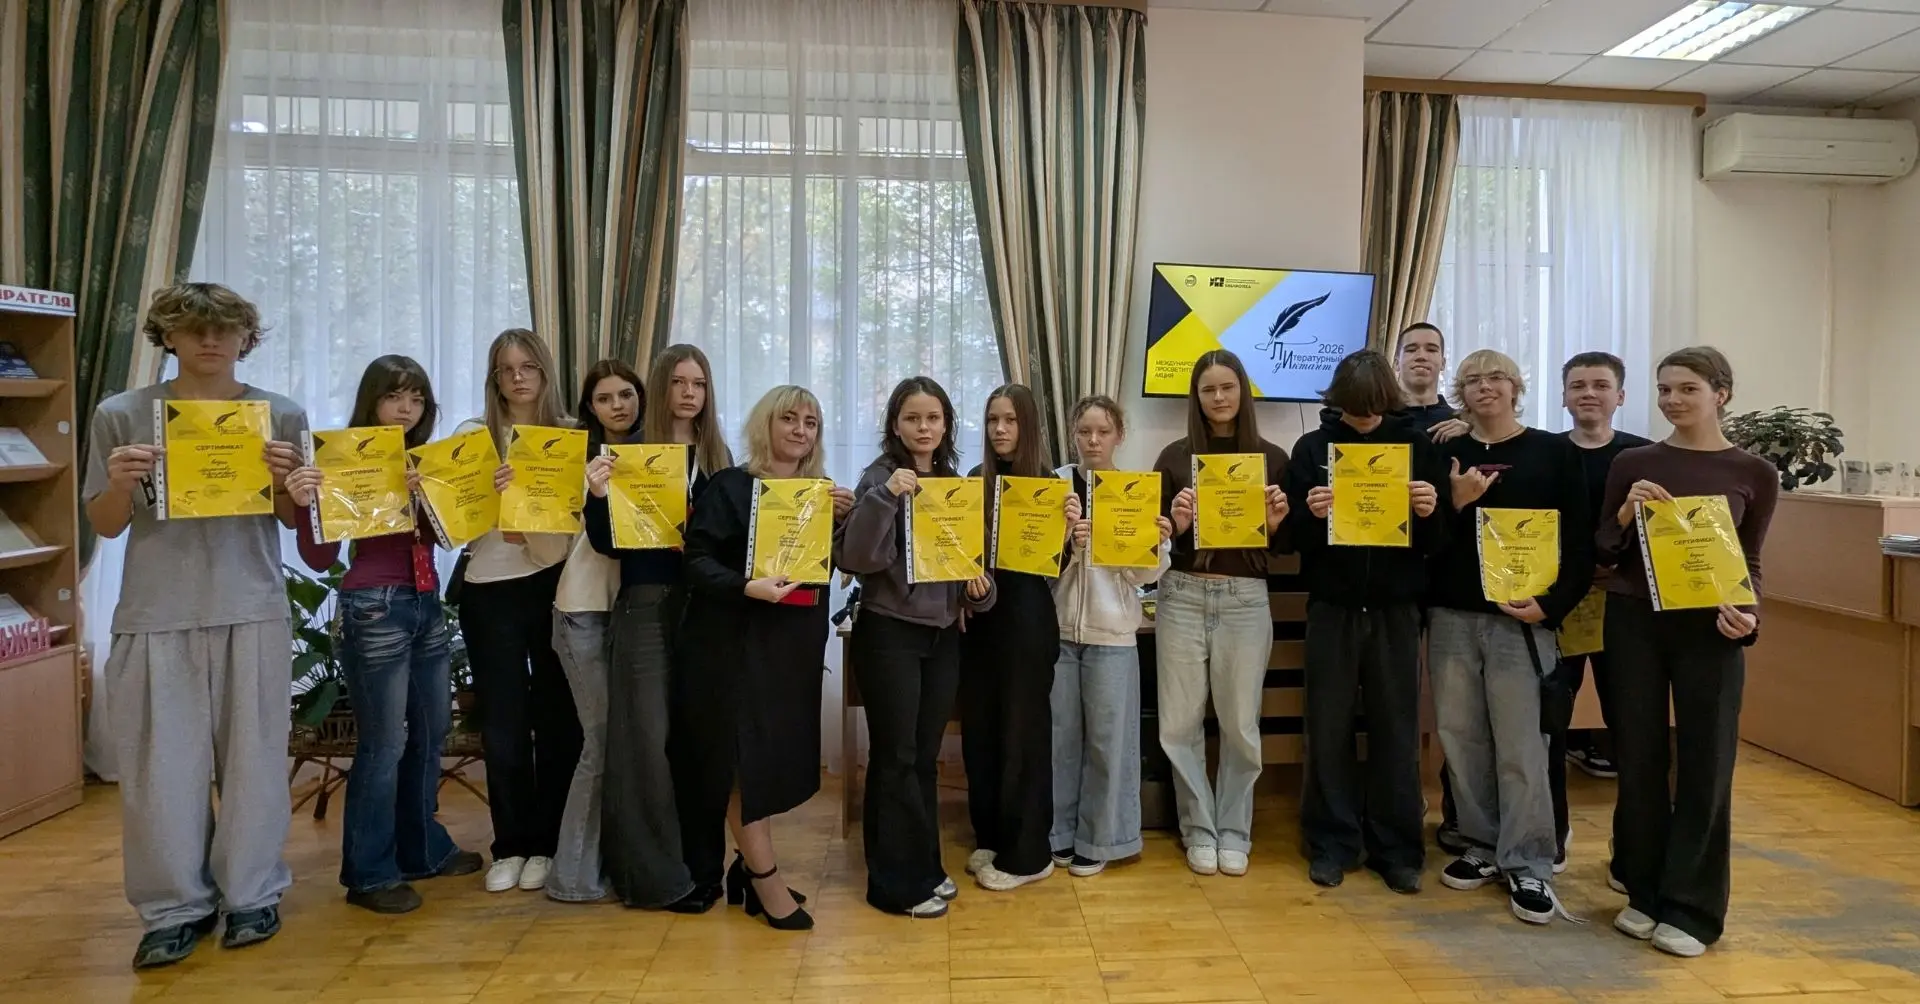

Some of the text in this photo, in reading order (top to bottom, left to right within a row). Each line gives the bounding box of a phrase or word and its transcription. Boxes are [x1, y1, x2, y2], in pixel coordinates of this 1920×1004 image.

[1318, 343, 1345, 354] 2026
[525, 465, 564, 473] СЕРТИФИКАТ
[1673, 537, 1715, 546] СЕРТИФИКАТ
